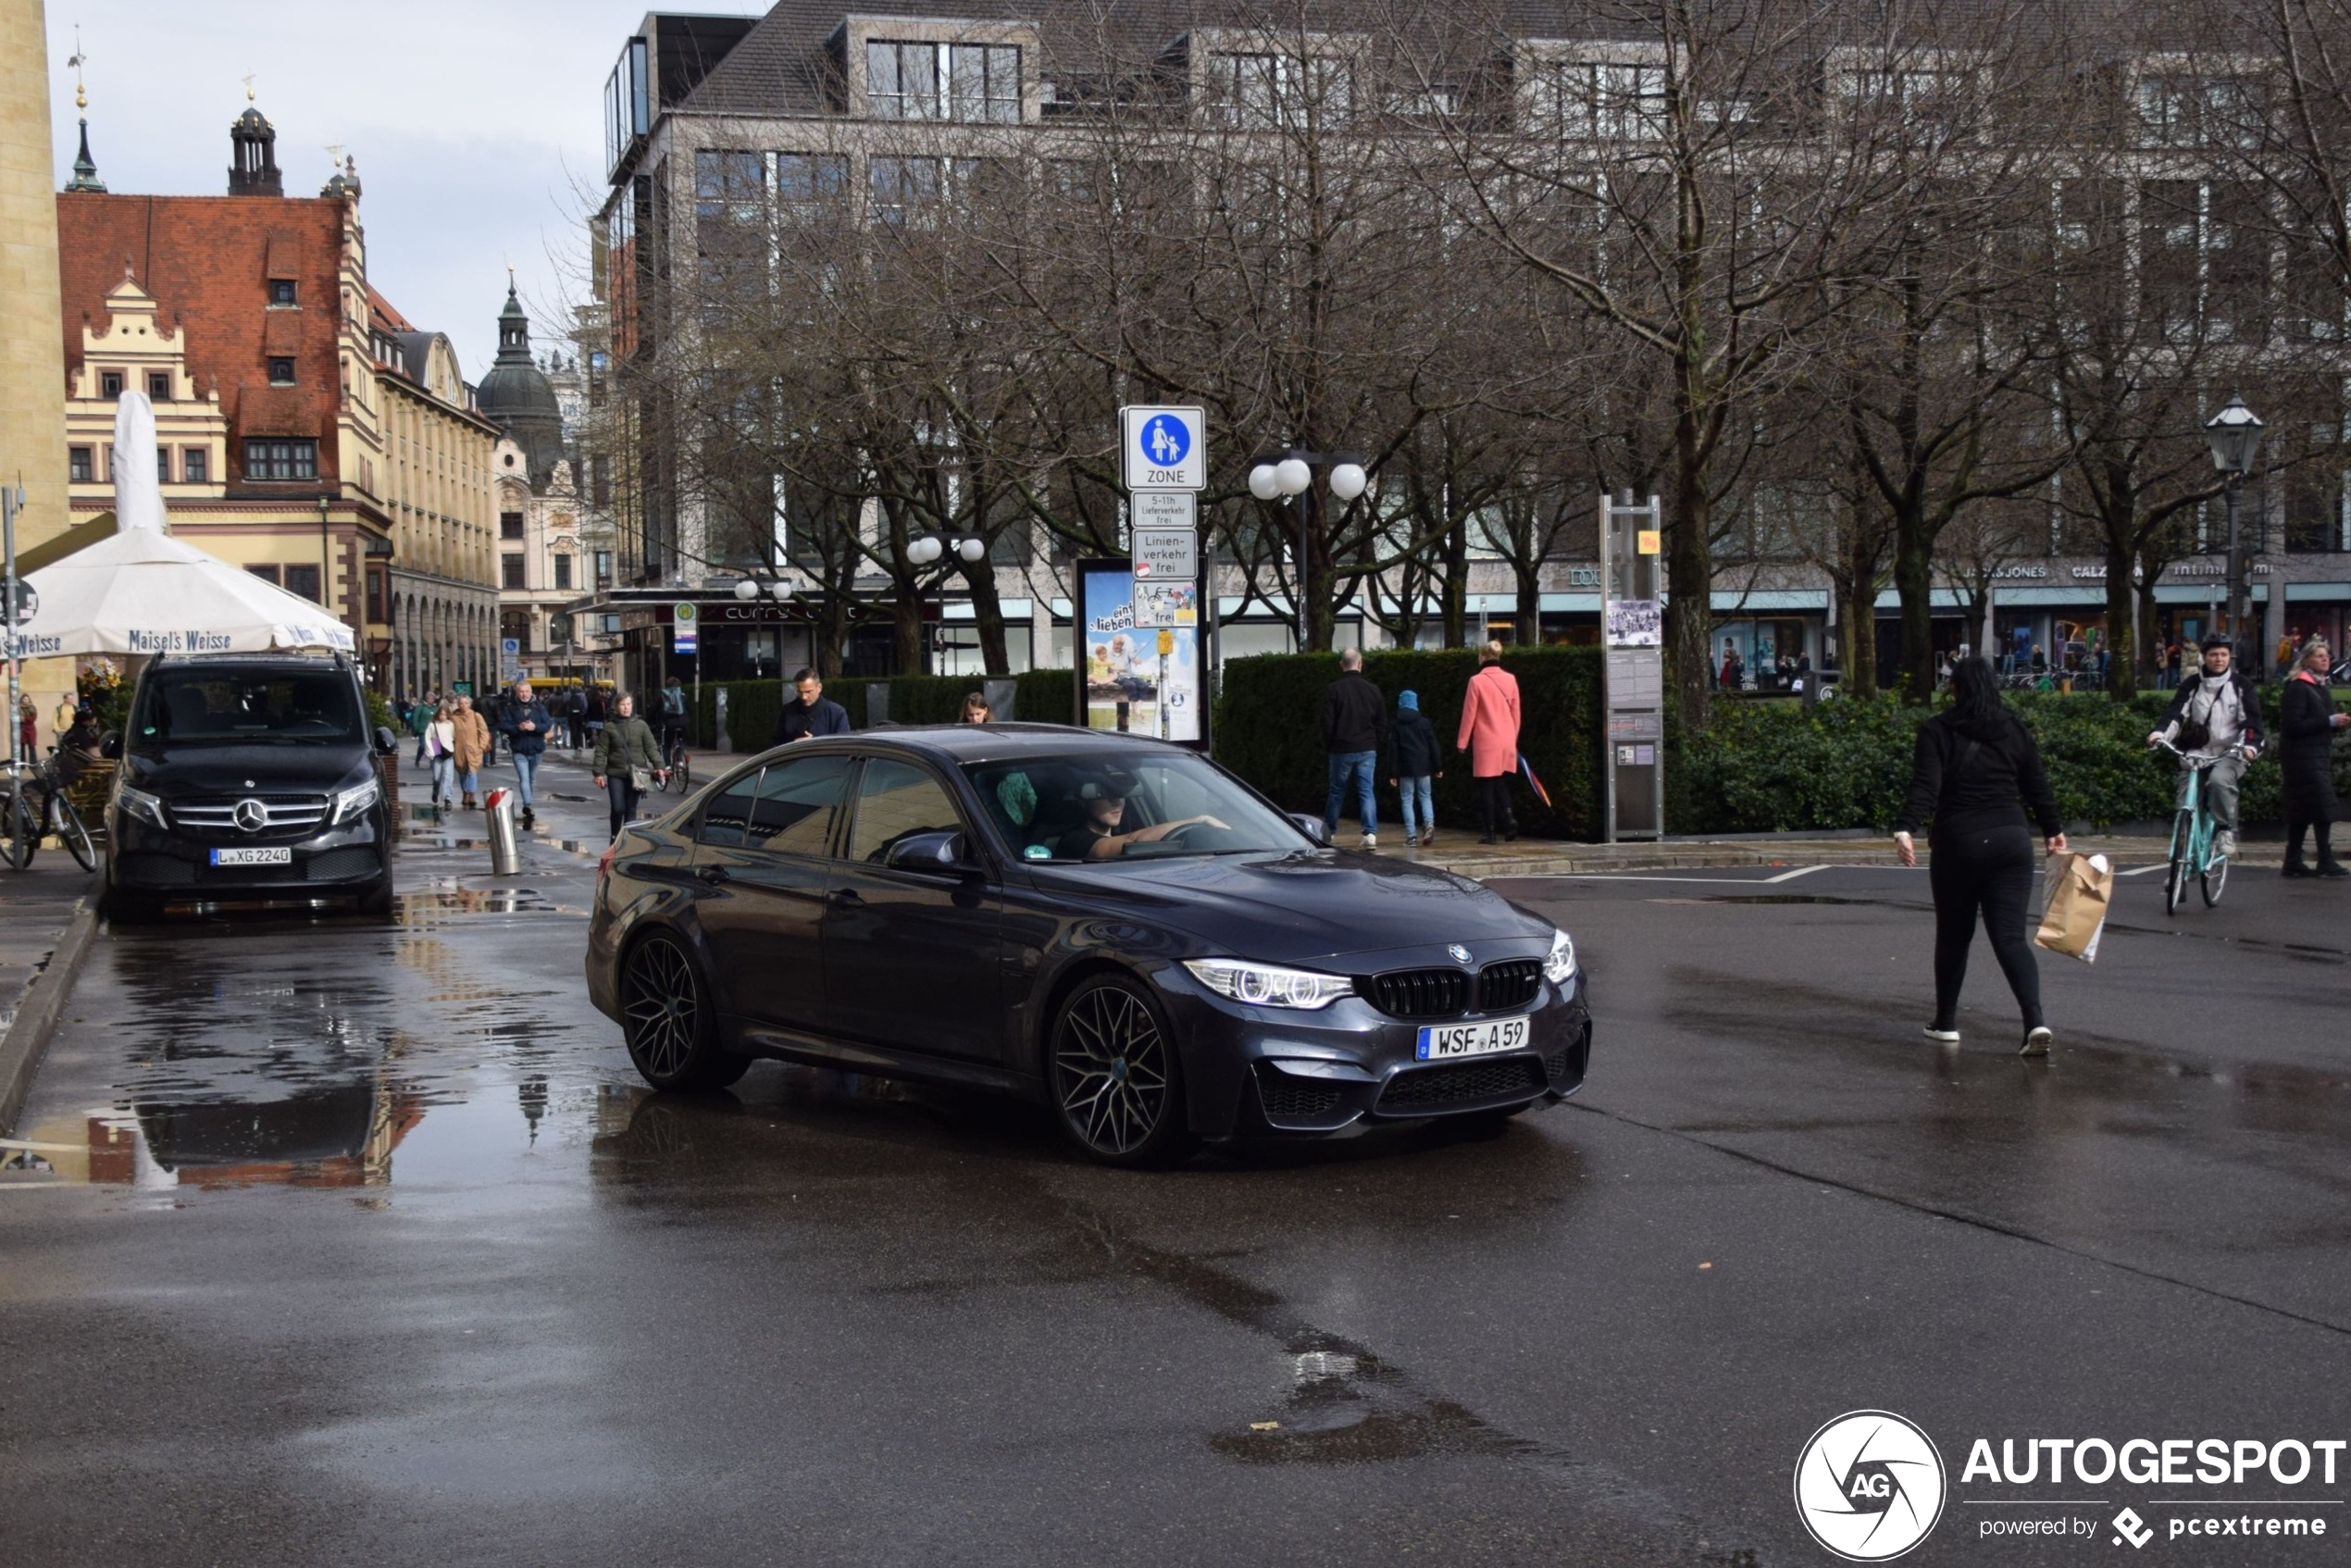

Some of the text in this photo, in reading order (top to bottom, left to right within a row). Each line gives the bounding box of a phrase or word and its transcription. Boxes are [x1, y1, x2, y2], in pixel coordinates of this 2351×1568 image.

[1147, 470, 1185, 483] ZONE
[1151, 496, 1176, 505] 5-11h
[1141, 506, 1186, 515] Lieferverkehr
[1156, 516, 1172, 524] frei
[1145, 536, 1185, 546] Linien-
[1143, 549, 1188, 560] verkehr
[1156, 562, 1176, 572] frei
[1155, 612, 1175, 623] frei
[1097, 617, 1132, 631] lieben
[128, 629, 231, 652] Maisel's Weisse
[219, 849, 289, 863] L XG 2240
[1438, 1027, 1477, 1054] WSF
[1487, 1025, 1499, 1050] A
[1503, 1021, 1524, 1047] 59
